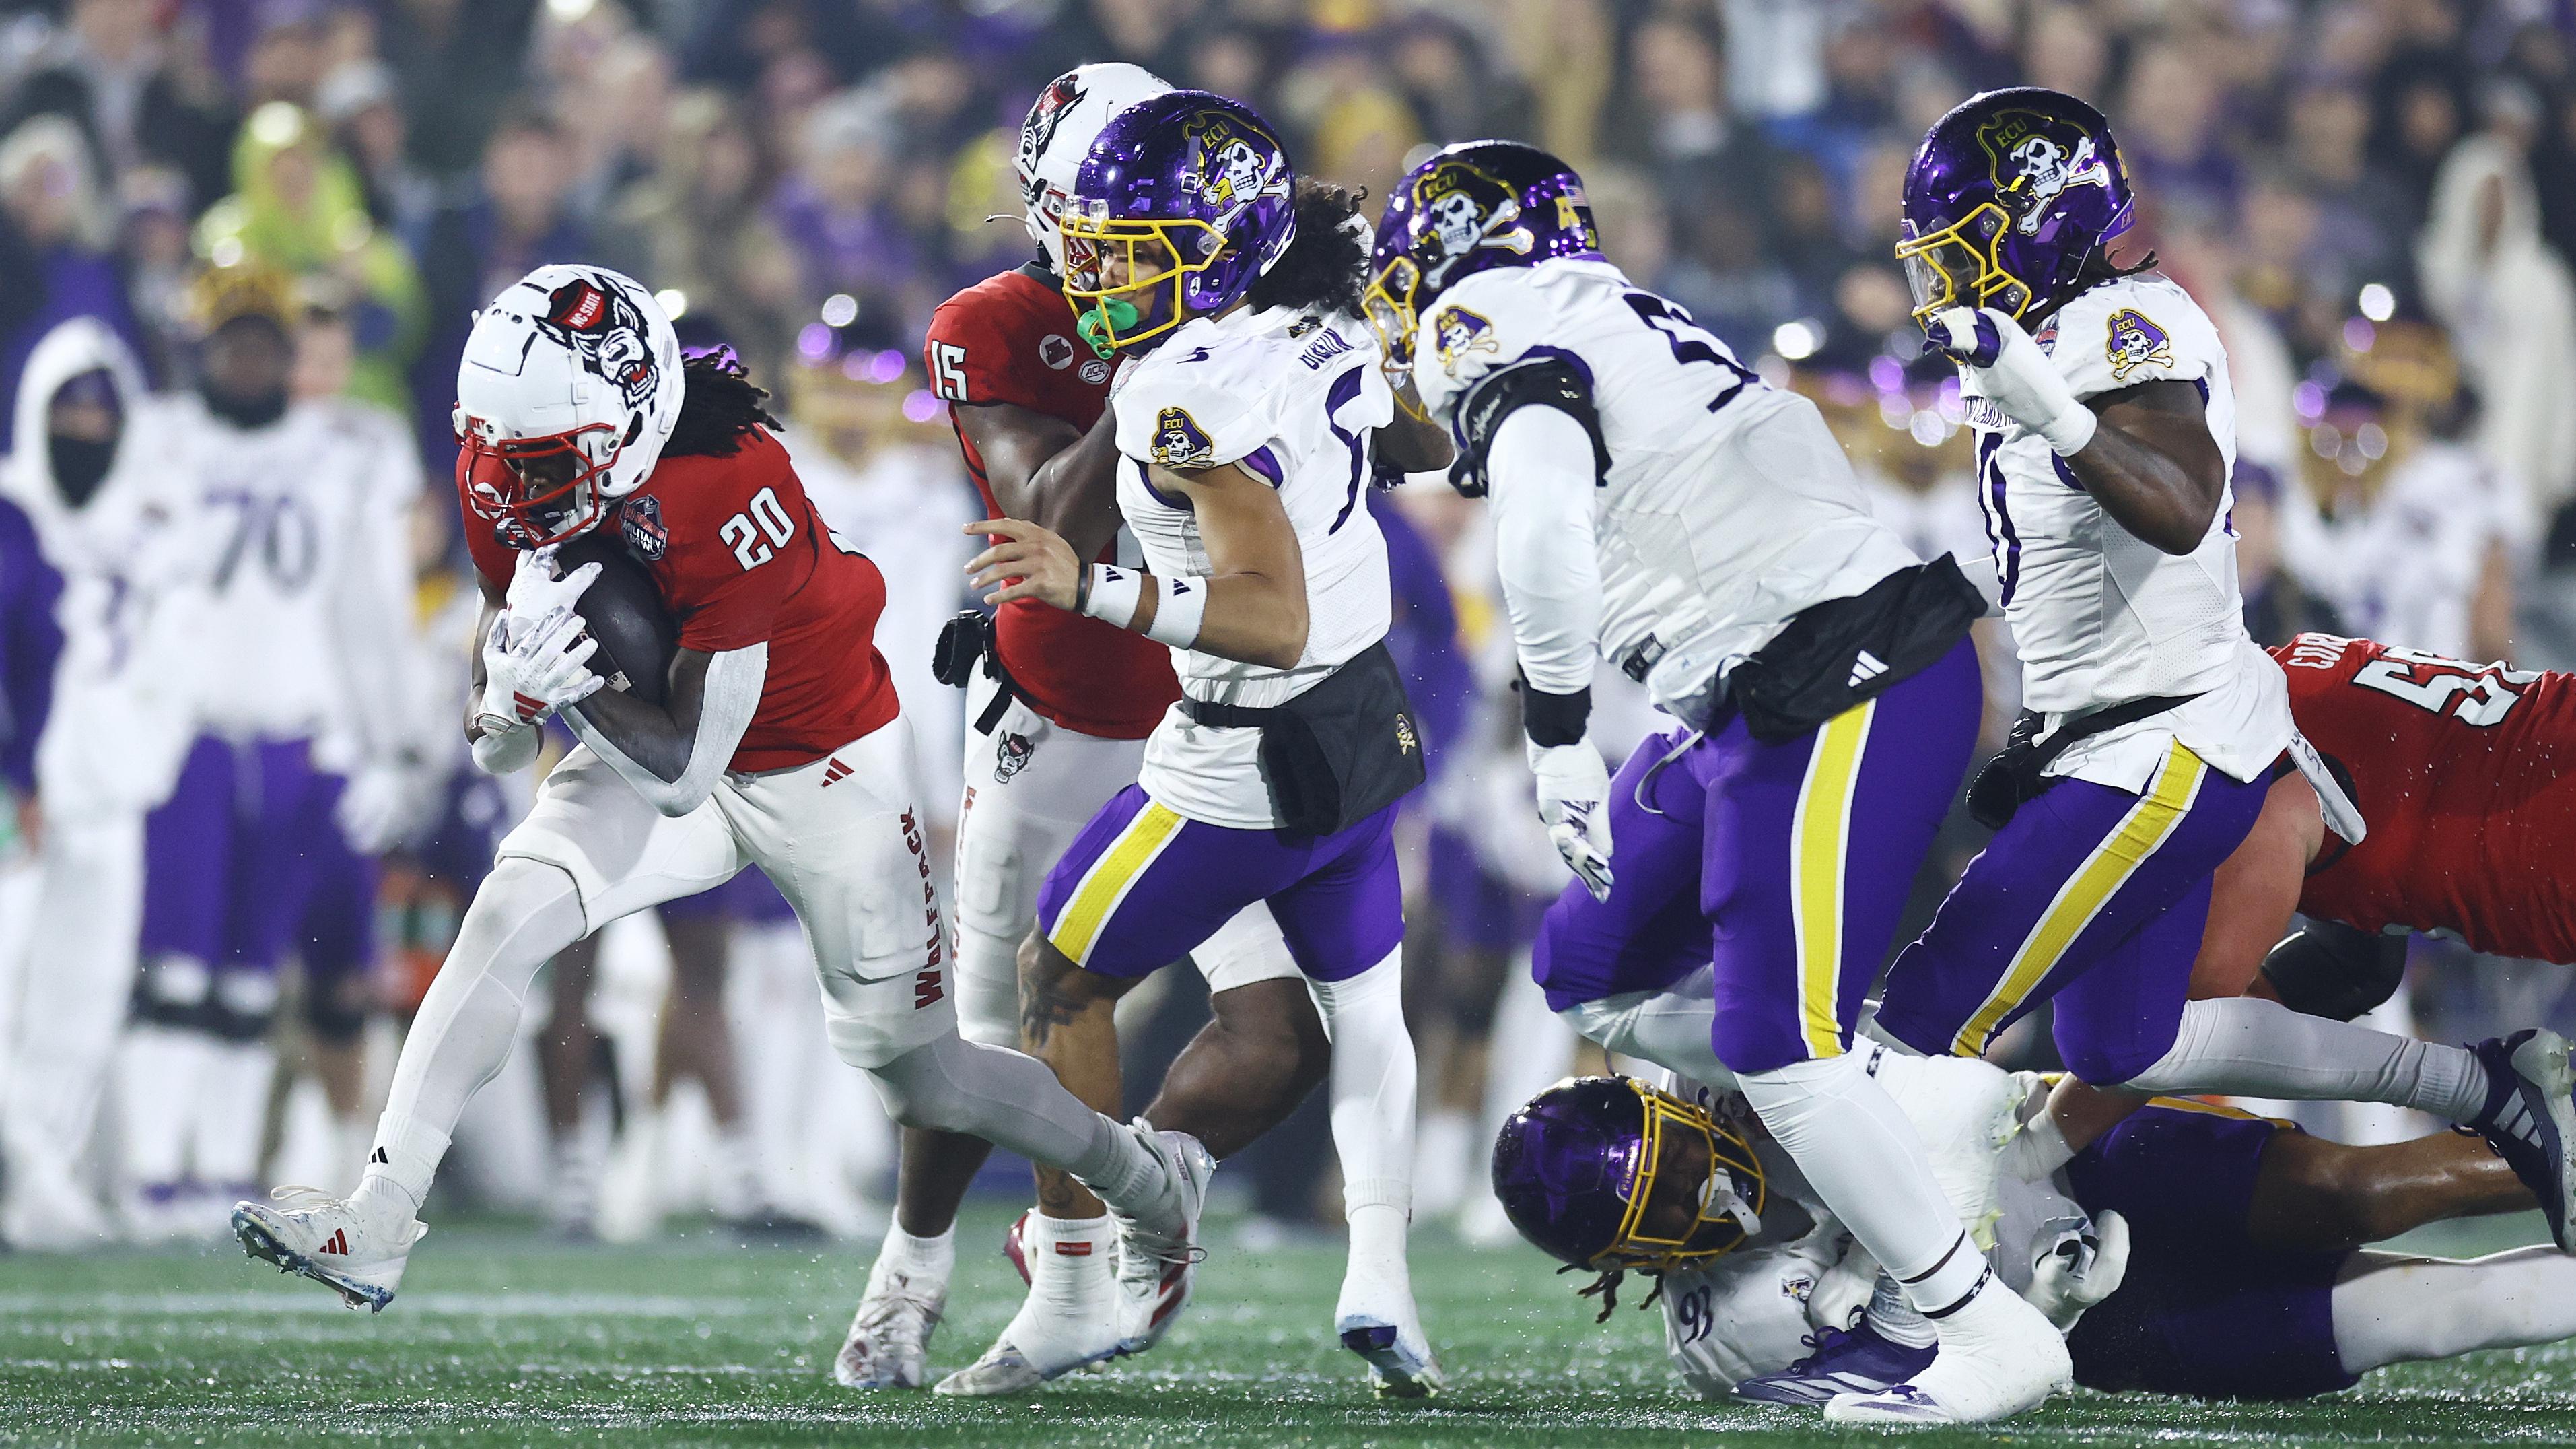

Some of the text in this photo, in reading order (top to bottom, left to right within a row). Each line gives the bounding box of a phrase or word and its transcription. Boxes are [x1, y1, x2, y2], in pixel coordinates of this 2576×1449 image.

[1202, 120, 1230, 149] ECU
[1995, 118, 2027, 148] ECU
[1425, 172, 1457, 199] ECU
[569, 291, 601, 327] NC STATE
[2116, 317, 2136, 333] ECU
[931, 339, 967, 401] 15
[1086, 366, 1105, 376] ACC
[1164, 418, 1184, 430] ECU
[201, 486, 322, 597] 70
[719, 486, 796, 571] 20
[900, 802, 944, 1010] WOLFPACK
[1679, 1284, 1714, 1345] 93
